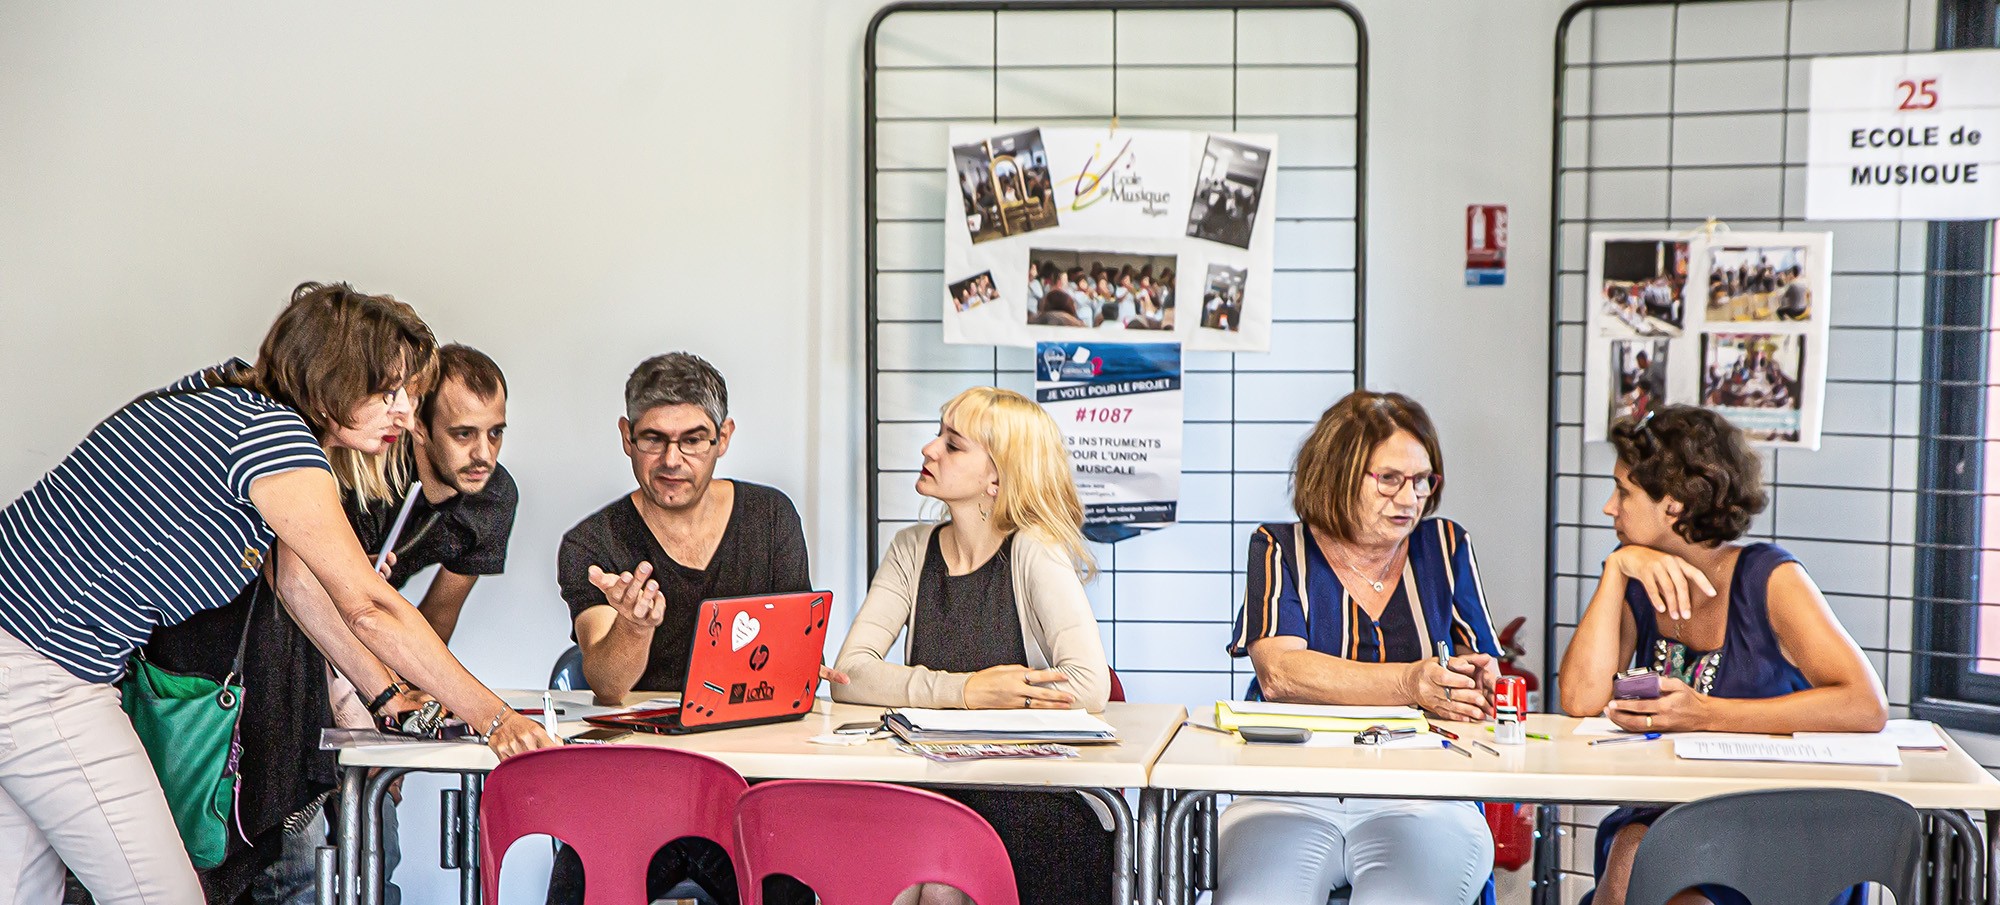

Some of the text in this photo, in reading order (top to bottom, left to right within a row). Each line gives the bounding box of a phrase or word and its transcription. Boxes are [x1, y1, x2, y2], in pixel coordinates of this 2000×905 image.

[1897, 79, 1939, 110] 25
[1851, 125, 1982, 148] ECOLE de
[1850, 163, 1979, 185] MUSIQUE
[1110, 186, 1170, 209] Musique
[1046, 378, 1170, 400] JE VOTE POUR LE PROJET
[1075, 407, 1133, 423] #1087
[1079, 437, 1161, 449] INSTRUMENTS
[1070, 450, 1148, 462] OUR L'UNION
[1076, 464, 1136, 475] MUSICALE
